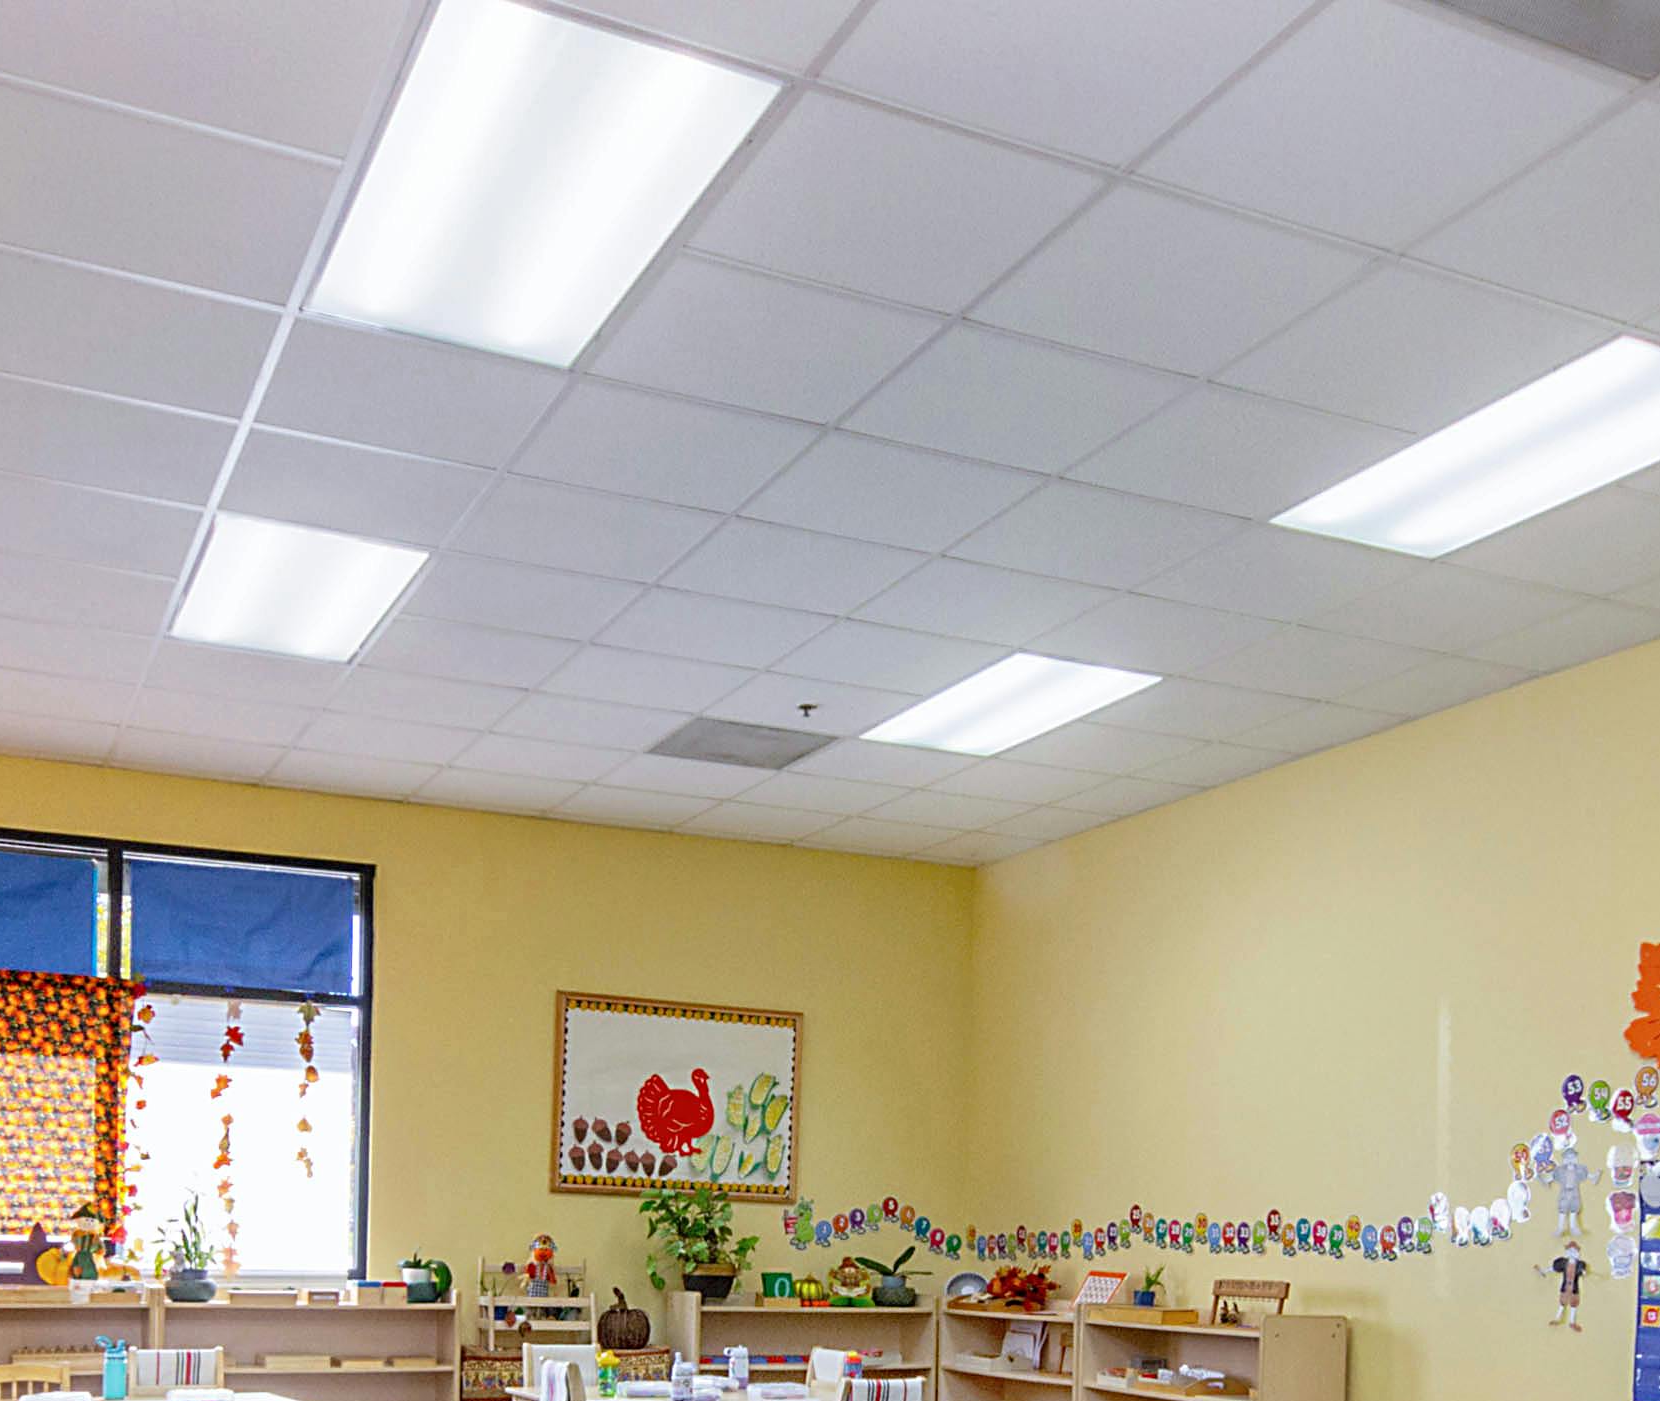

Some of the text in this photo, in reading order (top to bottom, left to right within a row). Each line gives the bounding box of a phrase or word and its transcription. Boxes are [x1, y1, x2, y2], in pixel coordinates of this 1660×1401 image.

[1567, 1079, 1583, 1095] 53
[1642, 1074, 1657, 1087] 56
[1594, 1087, 1609, 1101] 54
[1617, 1096, 1633, 1110] 55
[1554, 1116, 1569, 1129] 52
